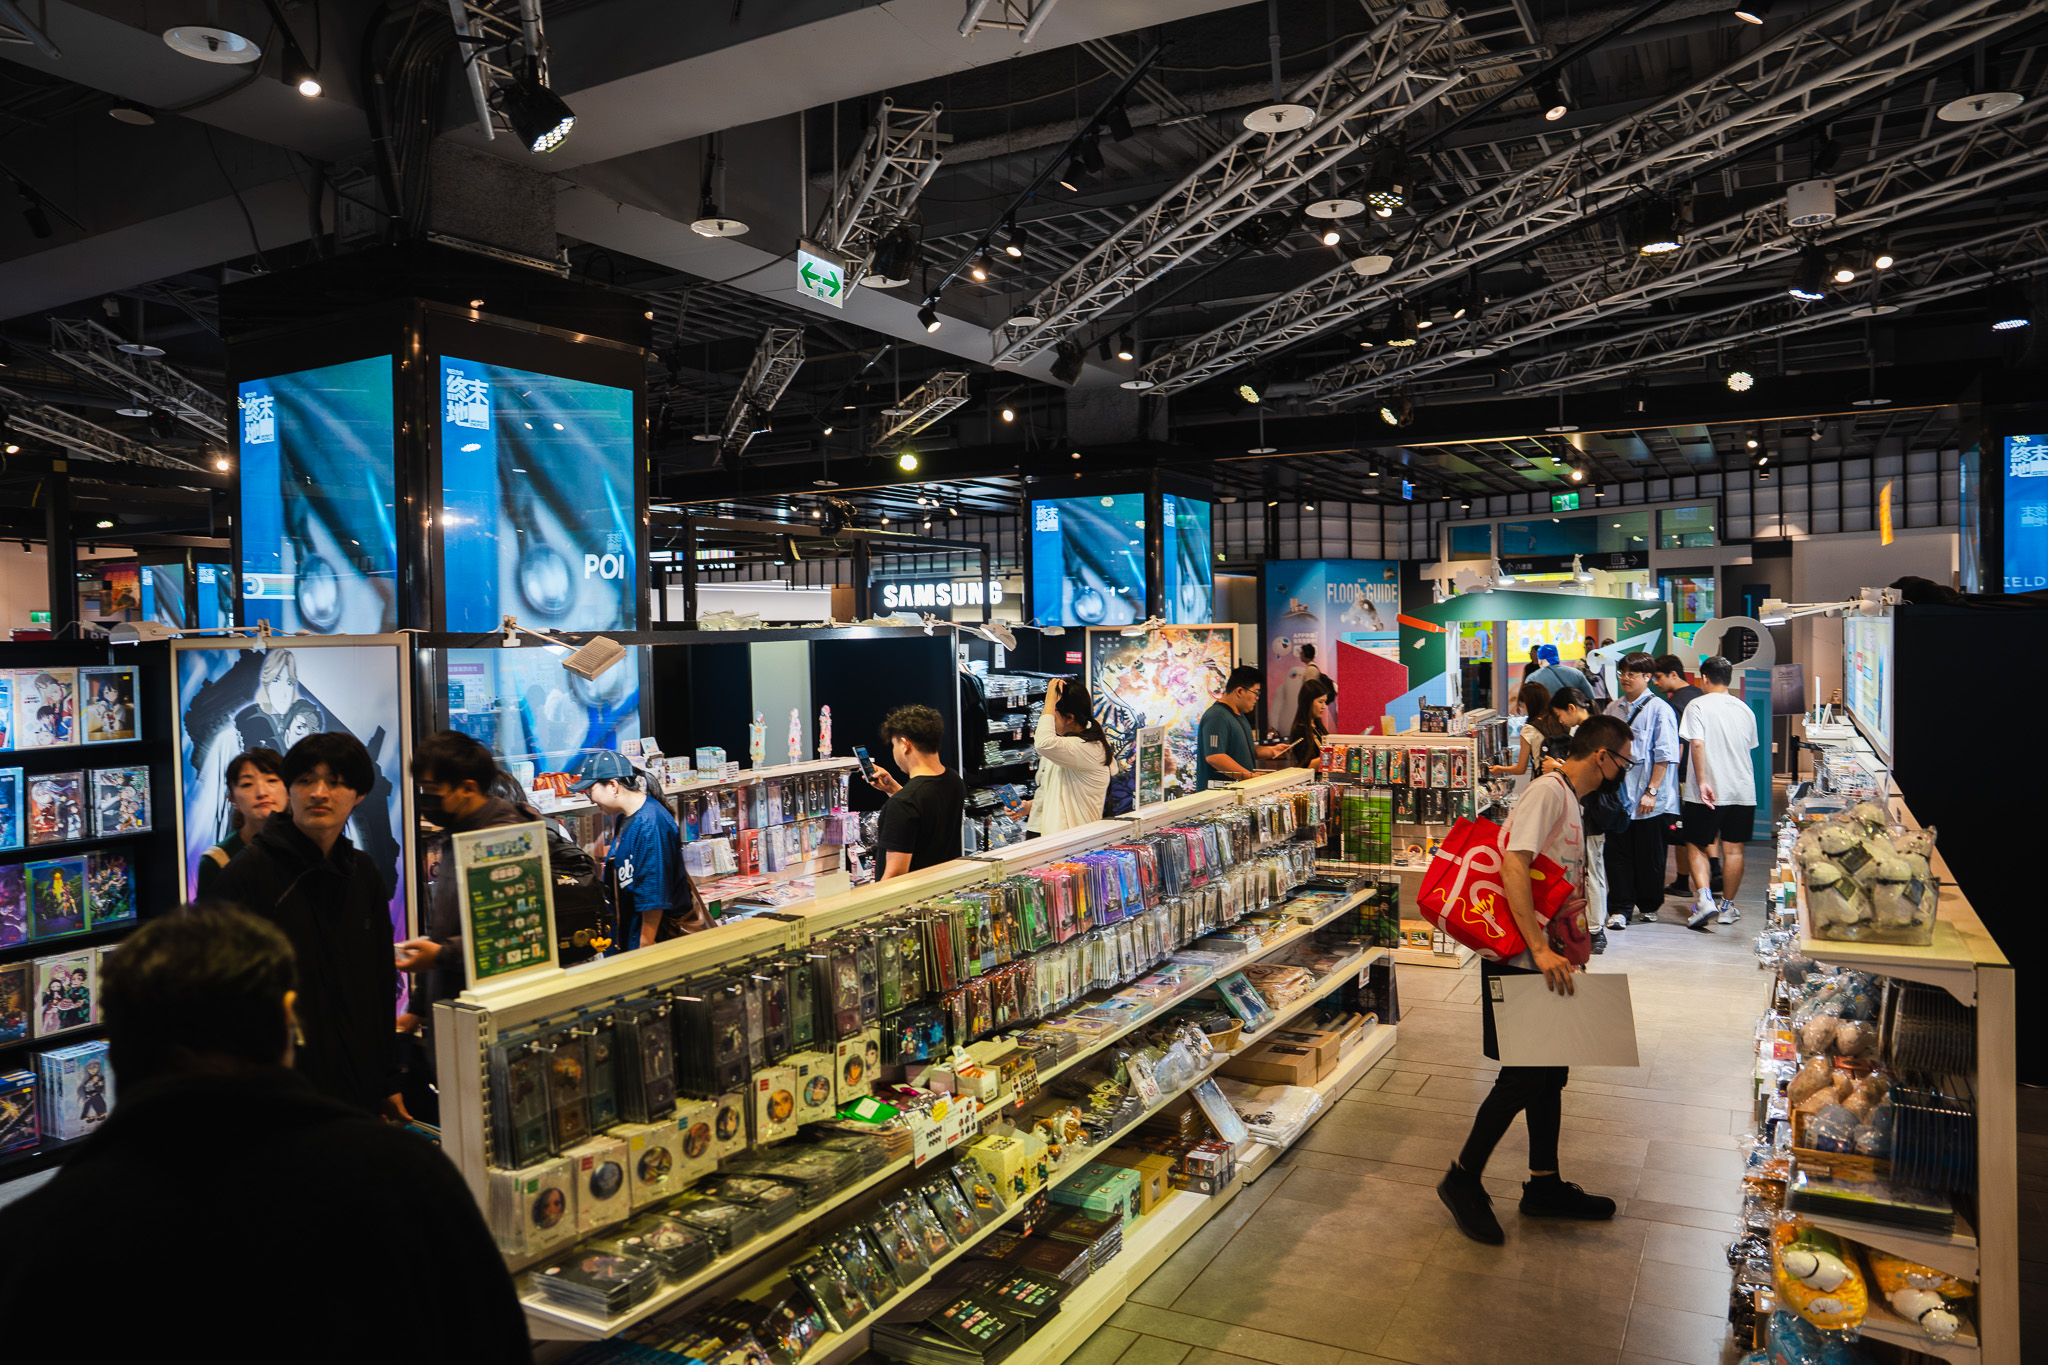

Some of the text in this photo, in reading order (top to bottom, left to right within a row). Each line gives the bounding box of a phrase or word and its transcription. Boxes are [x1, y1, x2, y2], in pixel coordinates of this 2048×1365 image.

[584, 554, 624, 579] POI
[883, 581, 1003, 608] SAMSUNG
[1327, 583, 1398, 603] FLOOR GUIDE
